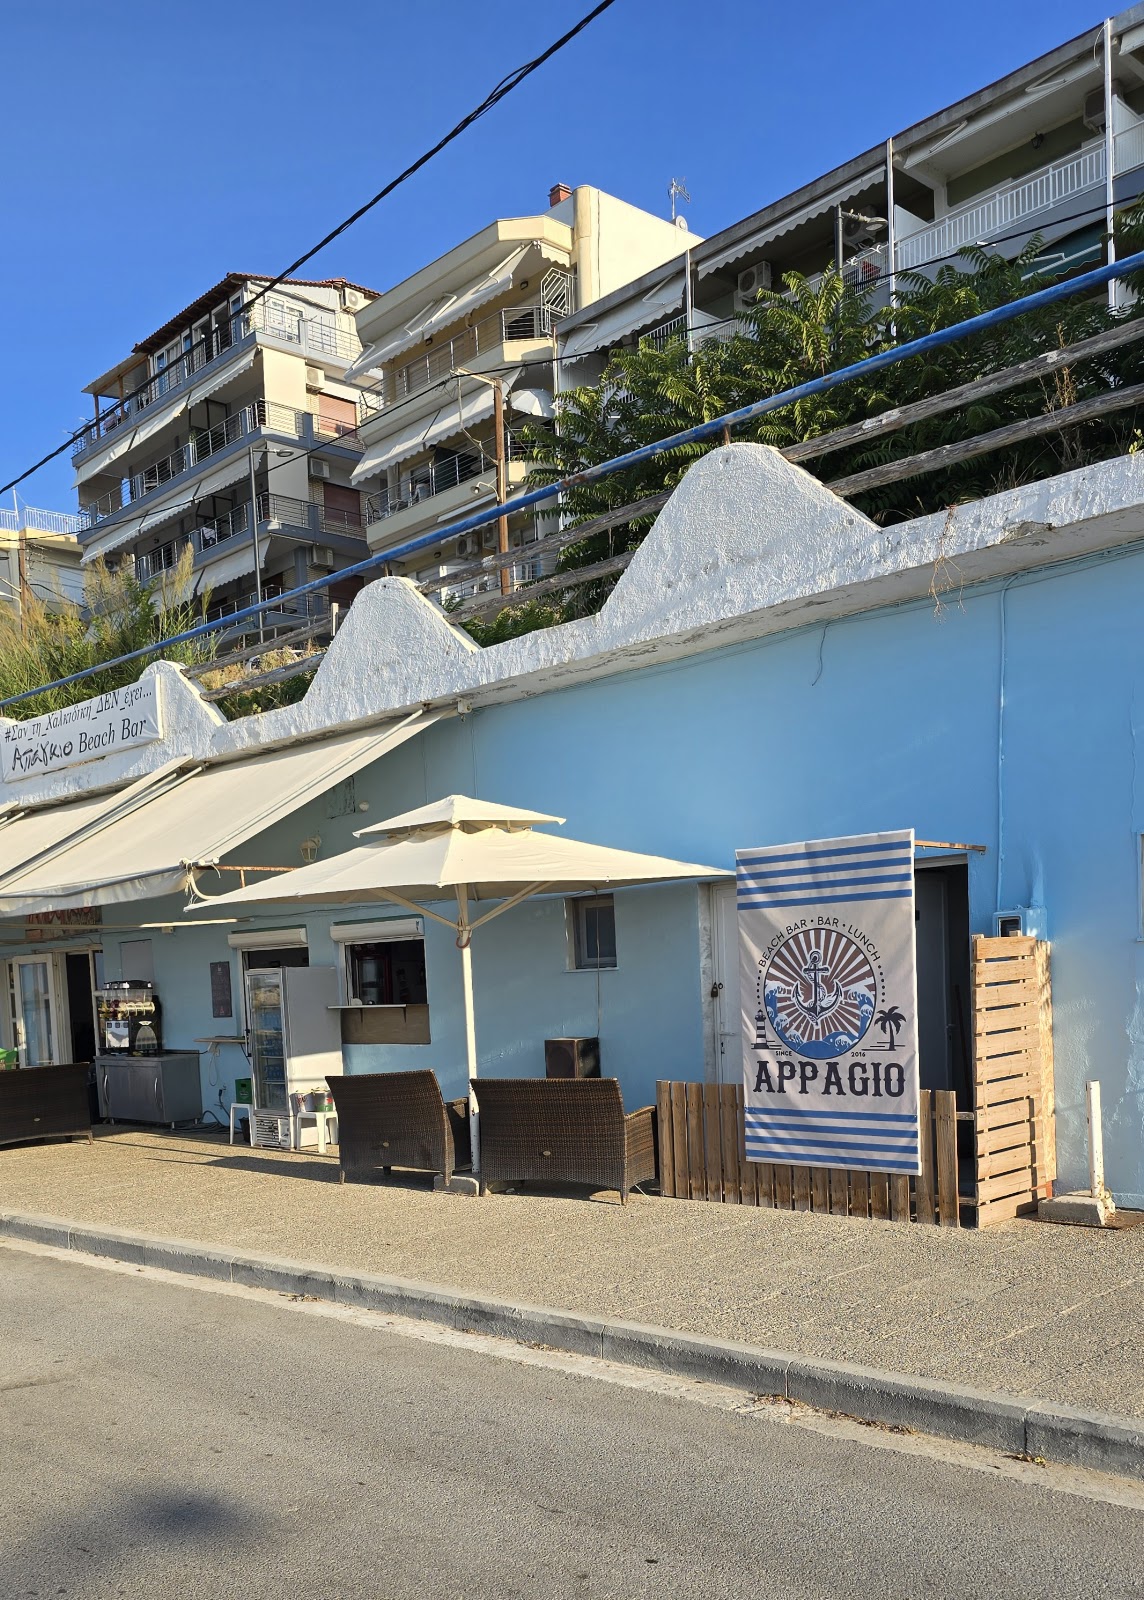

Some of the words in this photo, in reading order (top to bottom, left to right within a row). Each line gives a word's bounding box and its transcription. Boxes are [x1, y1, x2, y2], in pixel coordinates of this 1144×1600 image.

[12, 741, 73, 772] Απάγκιο
[79, 722, 115, 753] Beach
[121, 717, 146, 740] Bar
[758, 931, 785, 967] BEACH
[786, 919, 808, 935] BAR
[817, 916, 839, 928] BAR
[847, 925, 881, 962] LUNCH
[752, 1060, 906, 1098] APPAGIO
